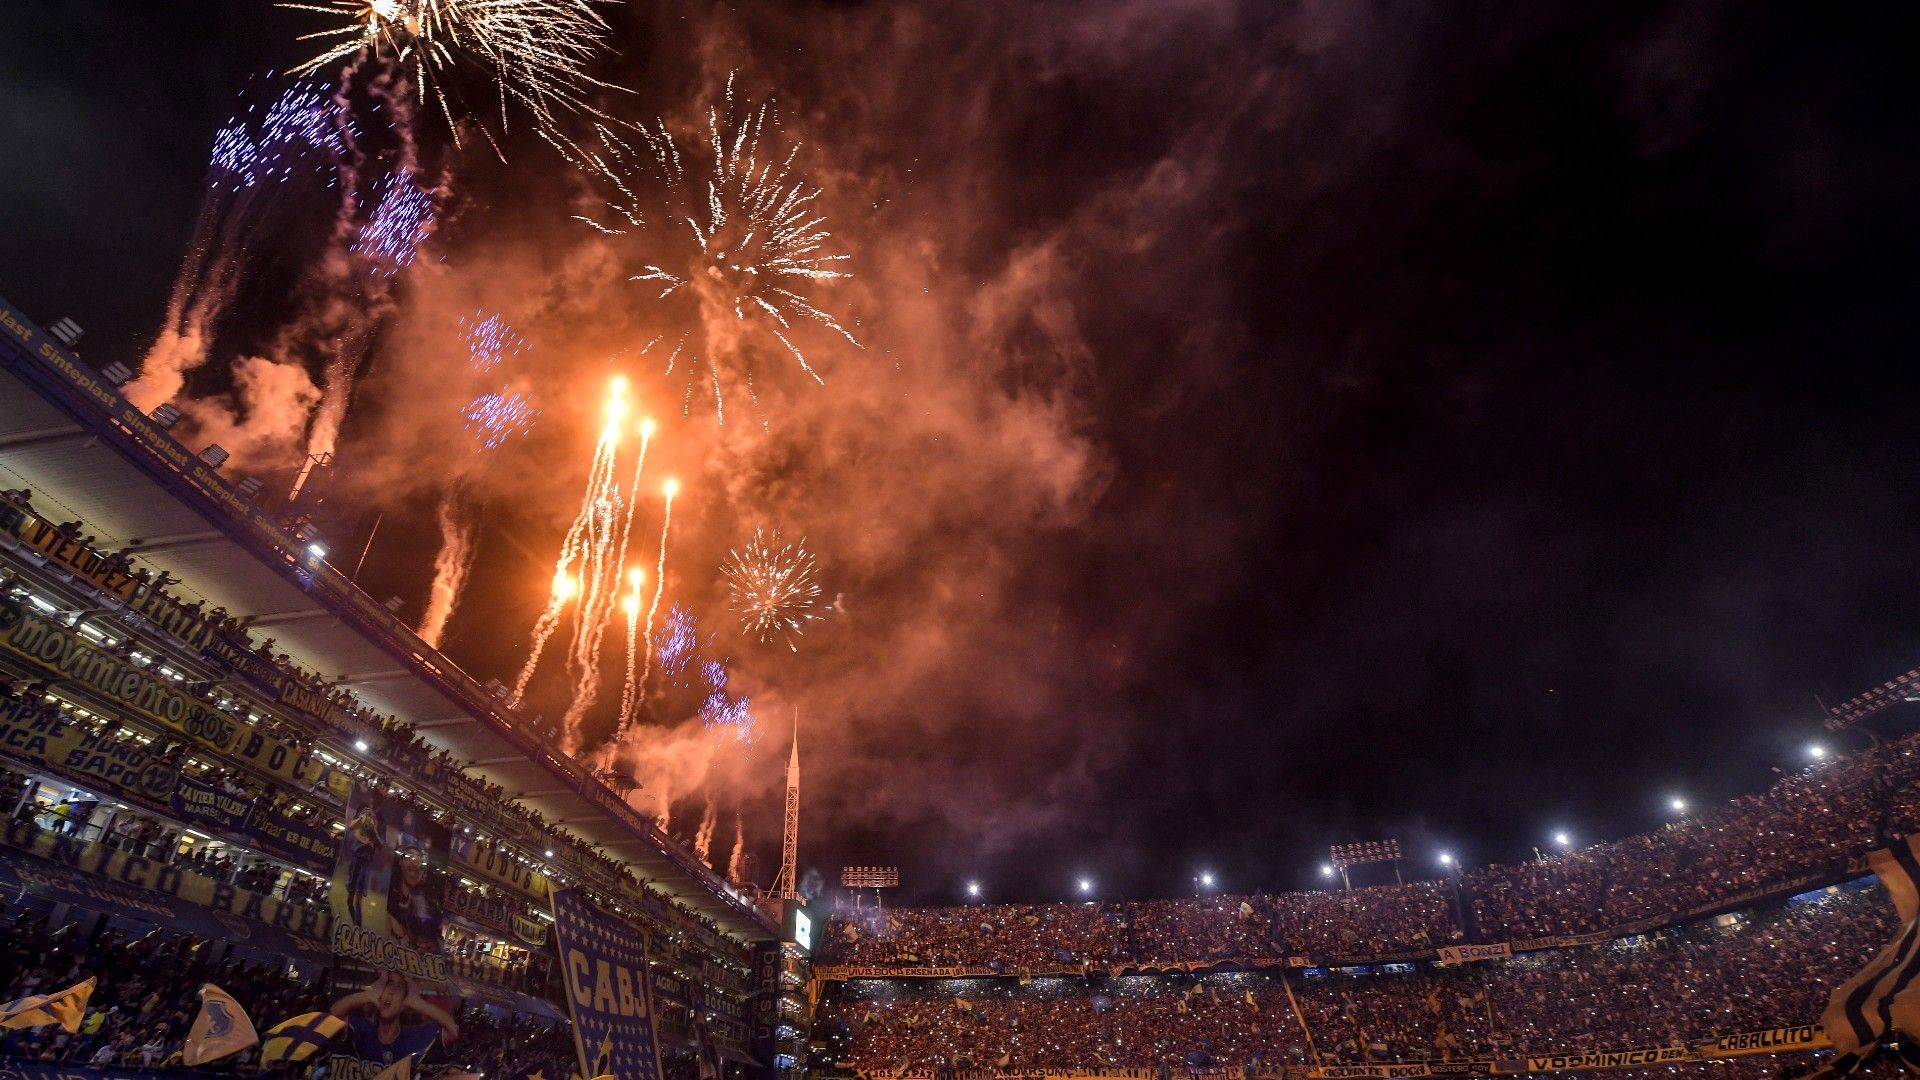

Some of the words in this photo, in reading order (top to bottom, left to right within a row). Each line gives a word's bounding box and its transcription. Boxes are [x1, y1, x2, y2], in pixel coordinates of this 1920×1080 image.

[40, 343, 117, 408] Sinteplast
[122, 410, 188, 466] Sinteplast
[193, 466, 250, 515] Sinteplast
[184, 705, 235, 747] 805
[64, 749, 140, 786] SAPO
[243, 731, 328, 782] BOC
[1460, 945, 1505, 959] BONZI
[568, 948, 646, 1018] CABJ
[874, 968, 903, 976] BOCA
[1718, 1026, 1812, 1050] CABALLITO
[872, 1069, 897, 1078] JOS
[913, 1070, 932, 1078] PAZ
[1323, 1066, 1384, 1077] AGUANTE
[1389, 1064, 1425, 1077] BOCA
[1431, 1064, 1470, 1074] BOSTERO
